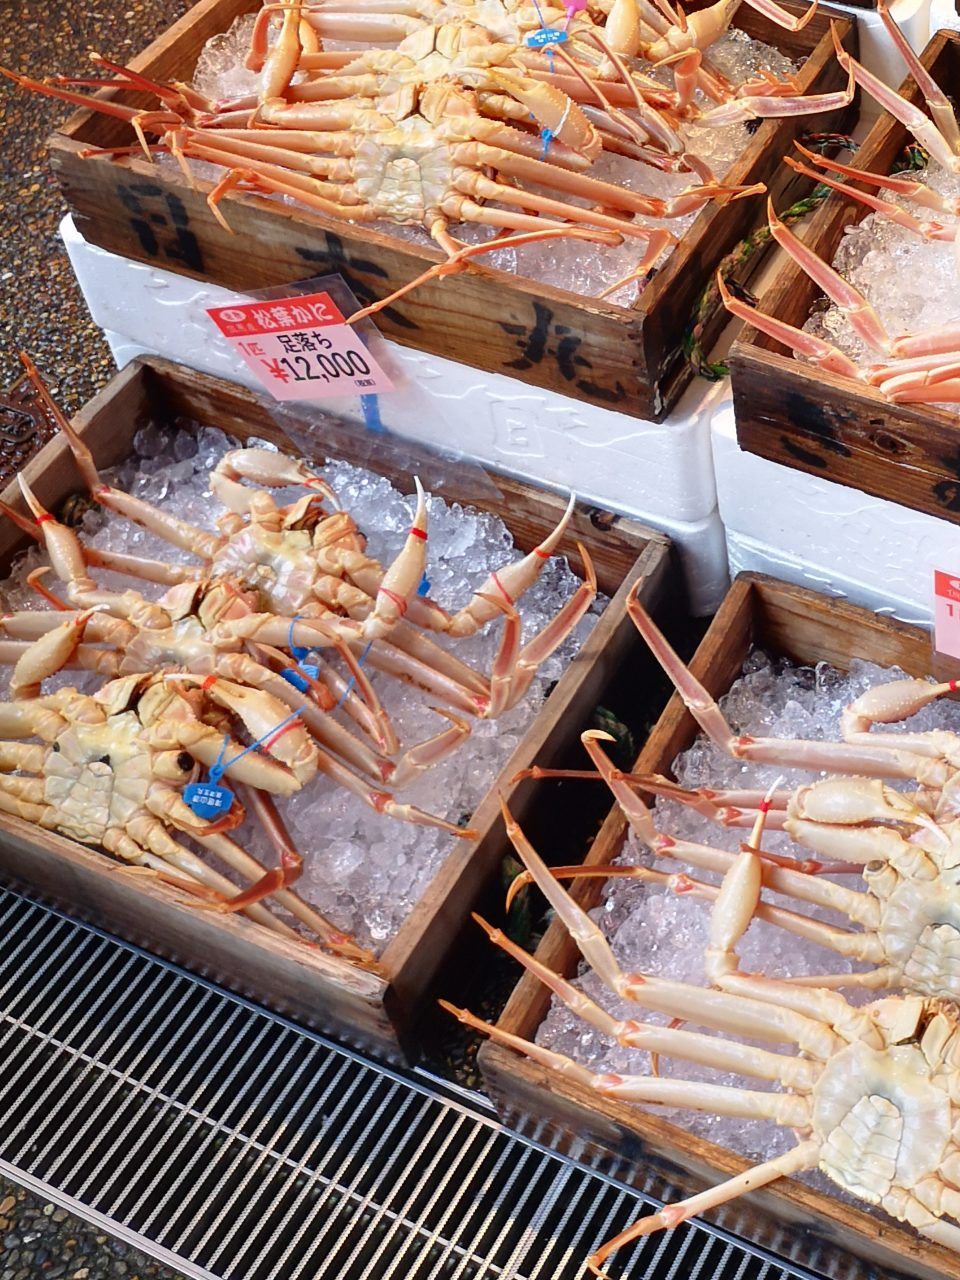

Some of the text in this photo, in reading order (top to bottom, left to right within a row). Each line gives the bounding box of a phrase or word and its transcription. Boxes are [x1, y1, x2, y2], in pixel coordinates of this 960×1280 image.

[253, 302, 334, 330] 松葉かに
[238, 341, 266, 357] 1匹
[276, 330, 333, 354] 足落ち
[260, 350, 371, 384] ¥12,000
